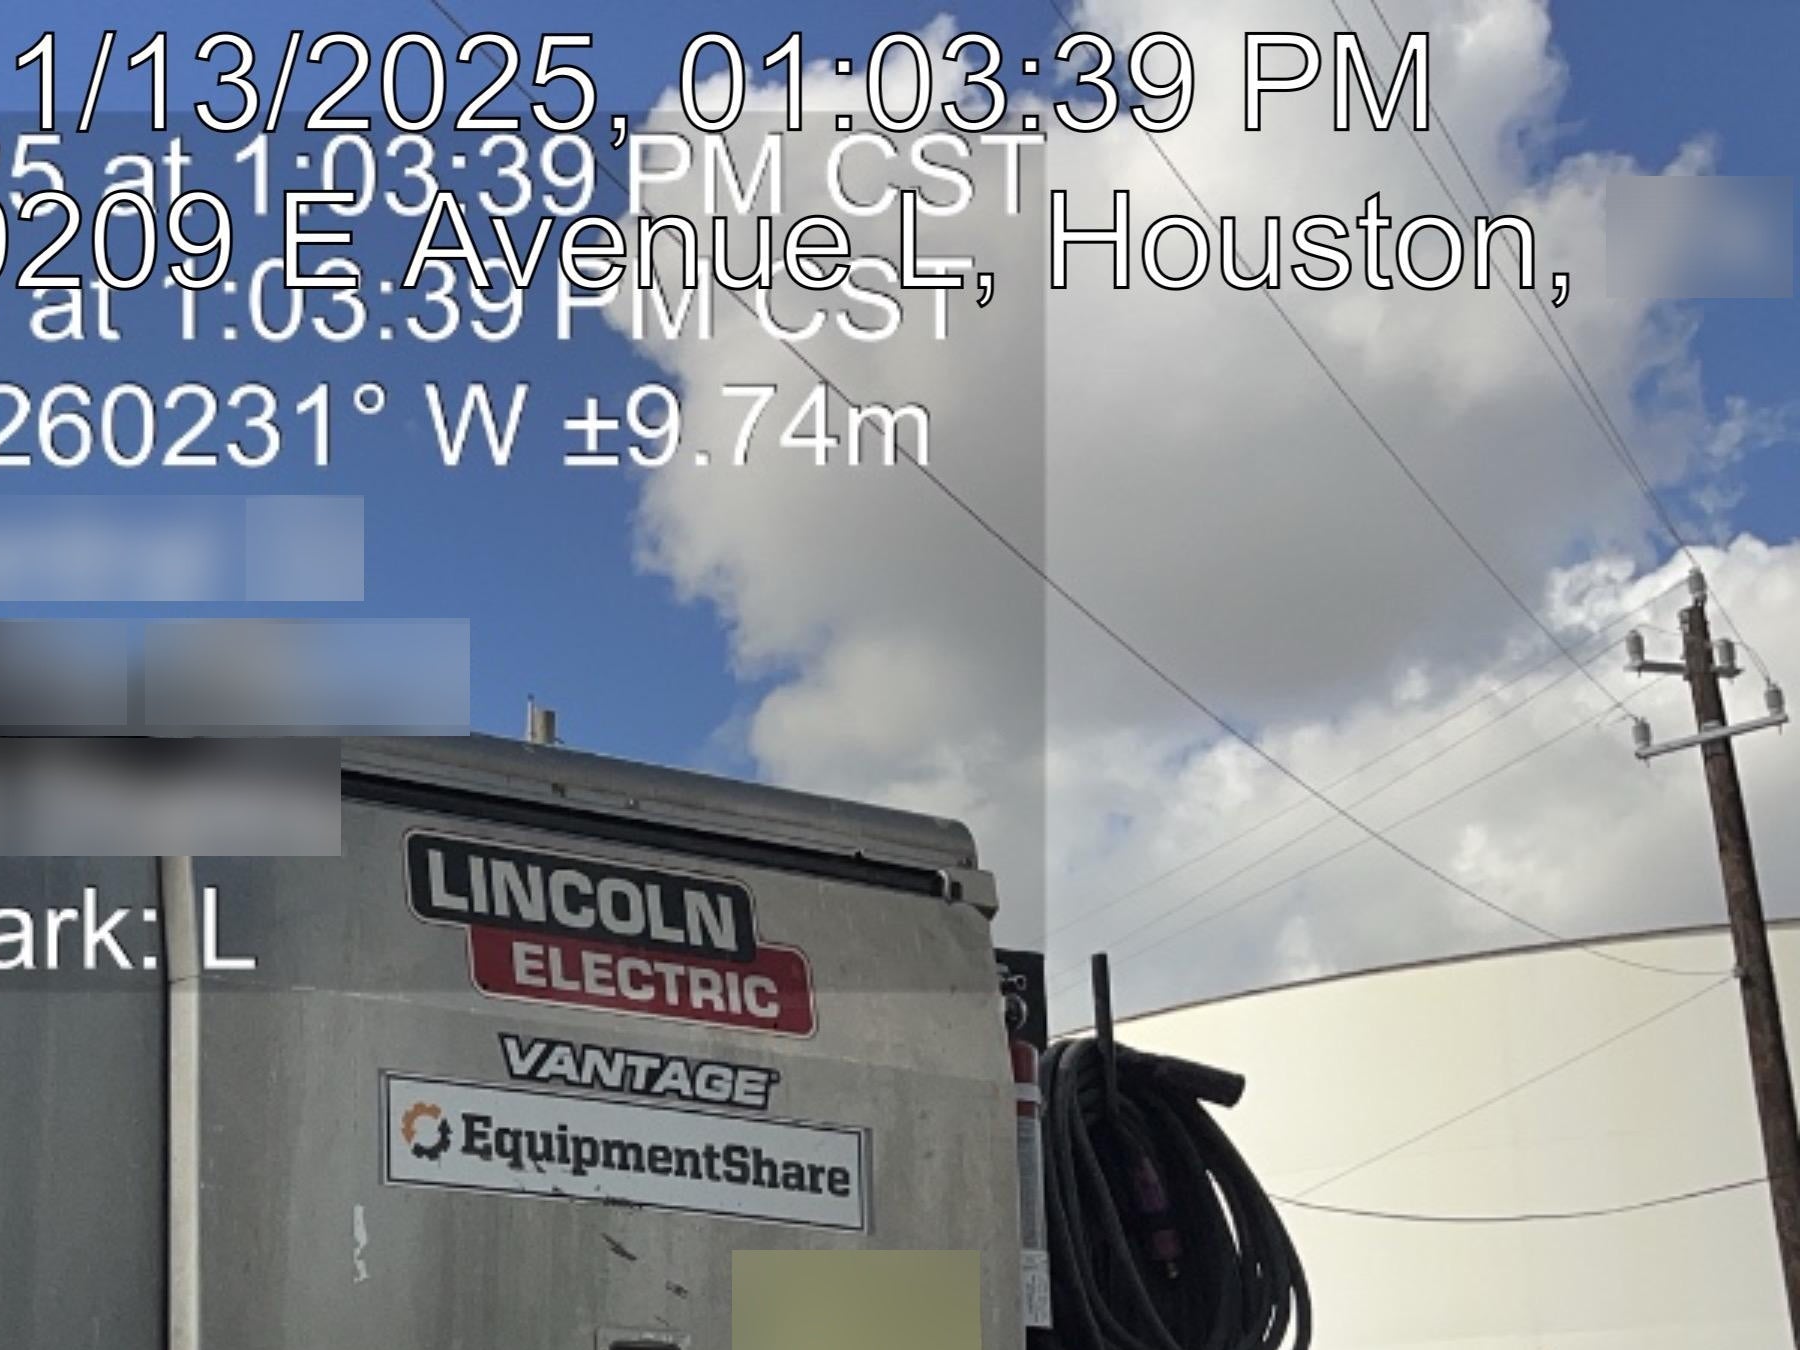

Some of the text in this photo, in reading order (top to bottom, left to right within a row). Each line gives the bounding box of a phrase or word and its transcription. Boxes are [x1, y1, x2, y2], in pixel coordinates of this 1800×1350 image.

[426, 848, 738, 952] LINCOLN
[511, 940, 780, 1019] ELECTRIC
[502, 1036, 770, 1107] VANTAGE
[461, 1112, 851, 1198] EquipmentShare
